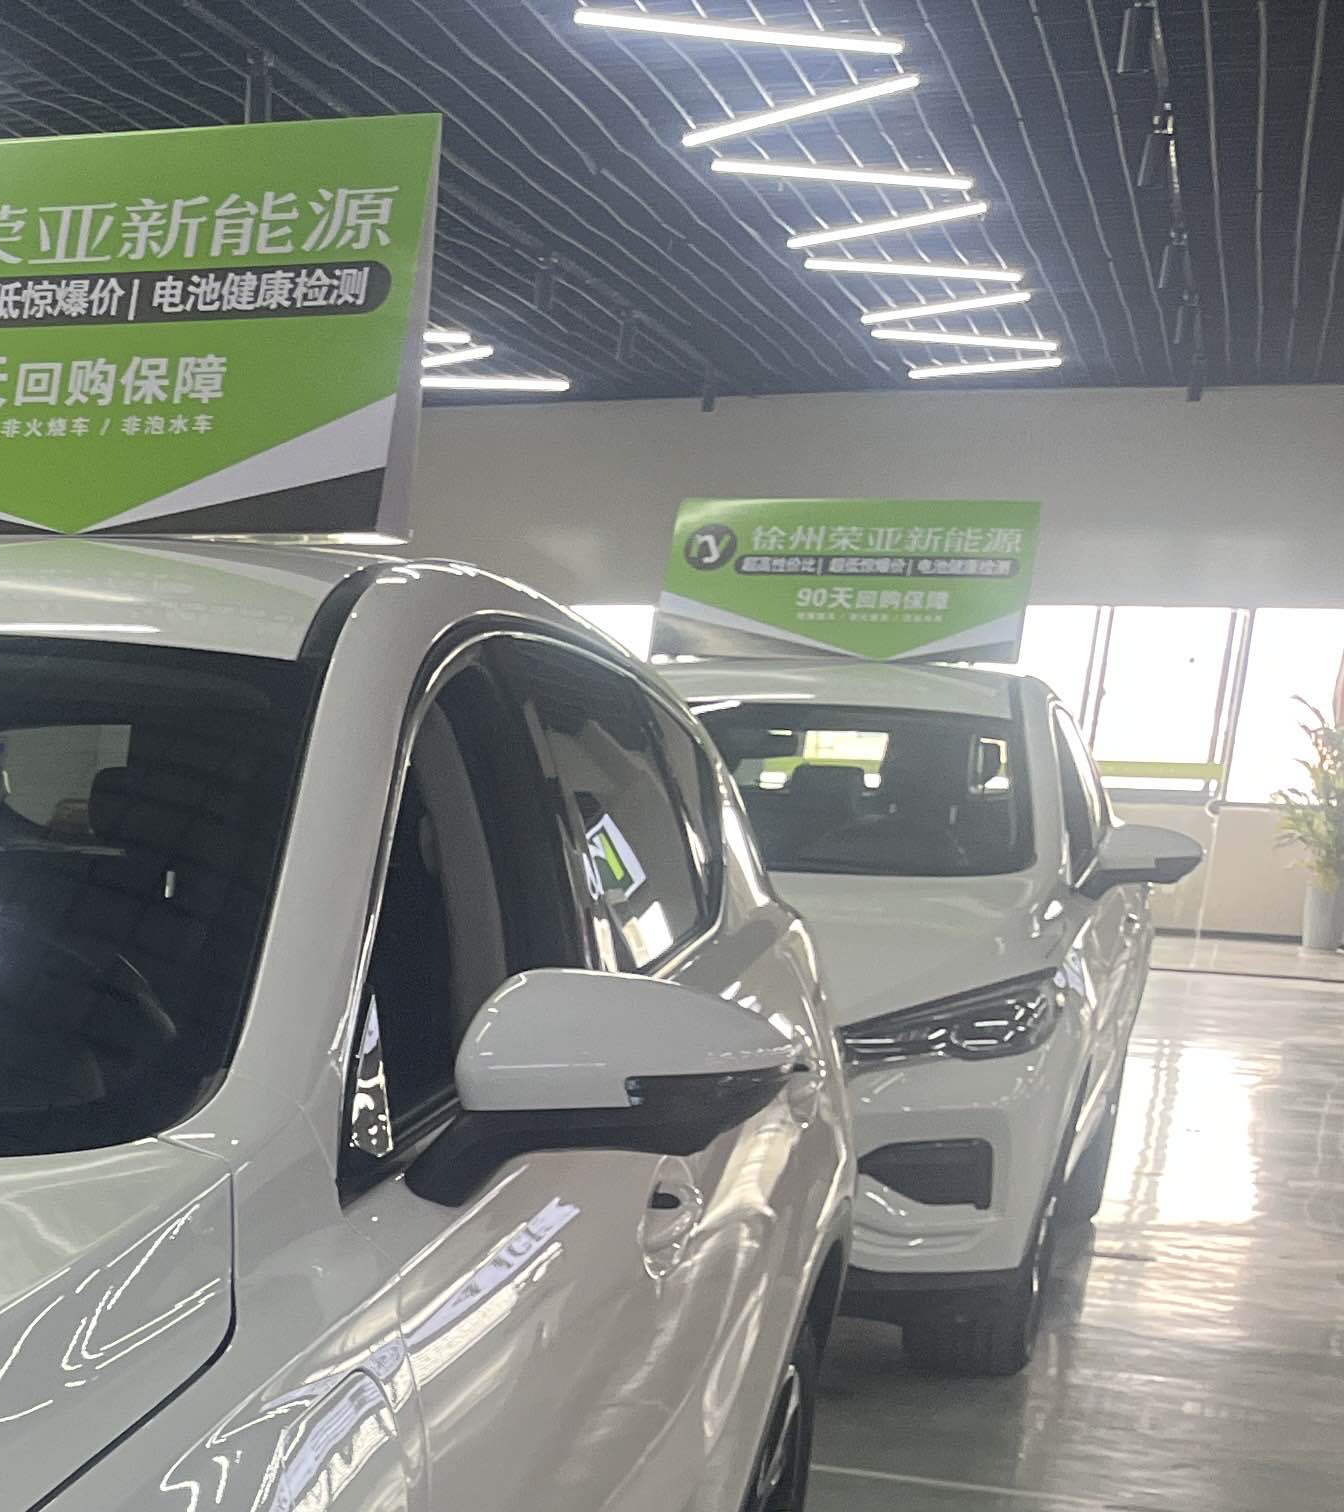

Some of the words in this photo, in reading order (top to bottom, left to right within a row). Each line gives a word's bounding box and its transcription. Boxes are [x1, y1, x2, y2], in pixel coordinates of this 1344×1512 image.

[152, 266, 370, 313] 电池健康检测
[0, 416, 90, 438] 非火烧车
[121, 413, 215, 436] 非泡水车
[751, 525, 1025, 553] 徐州荣亚新能源
